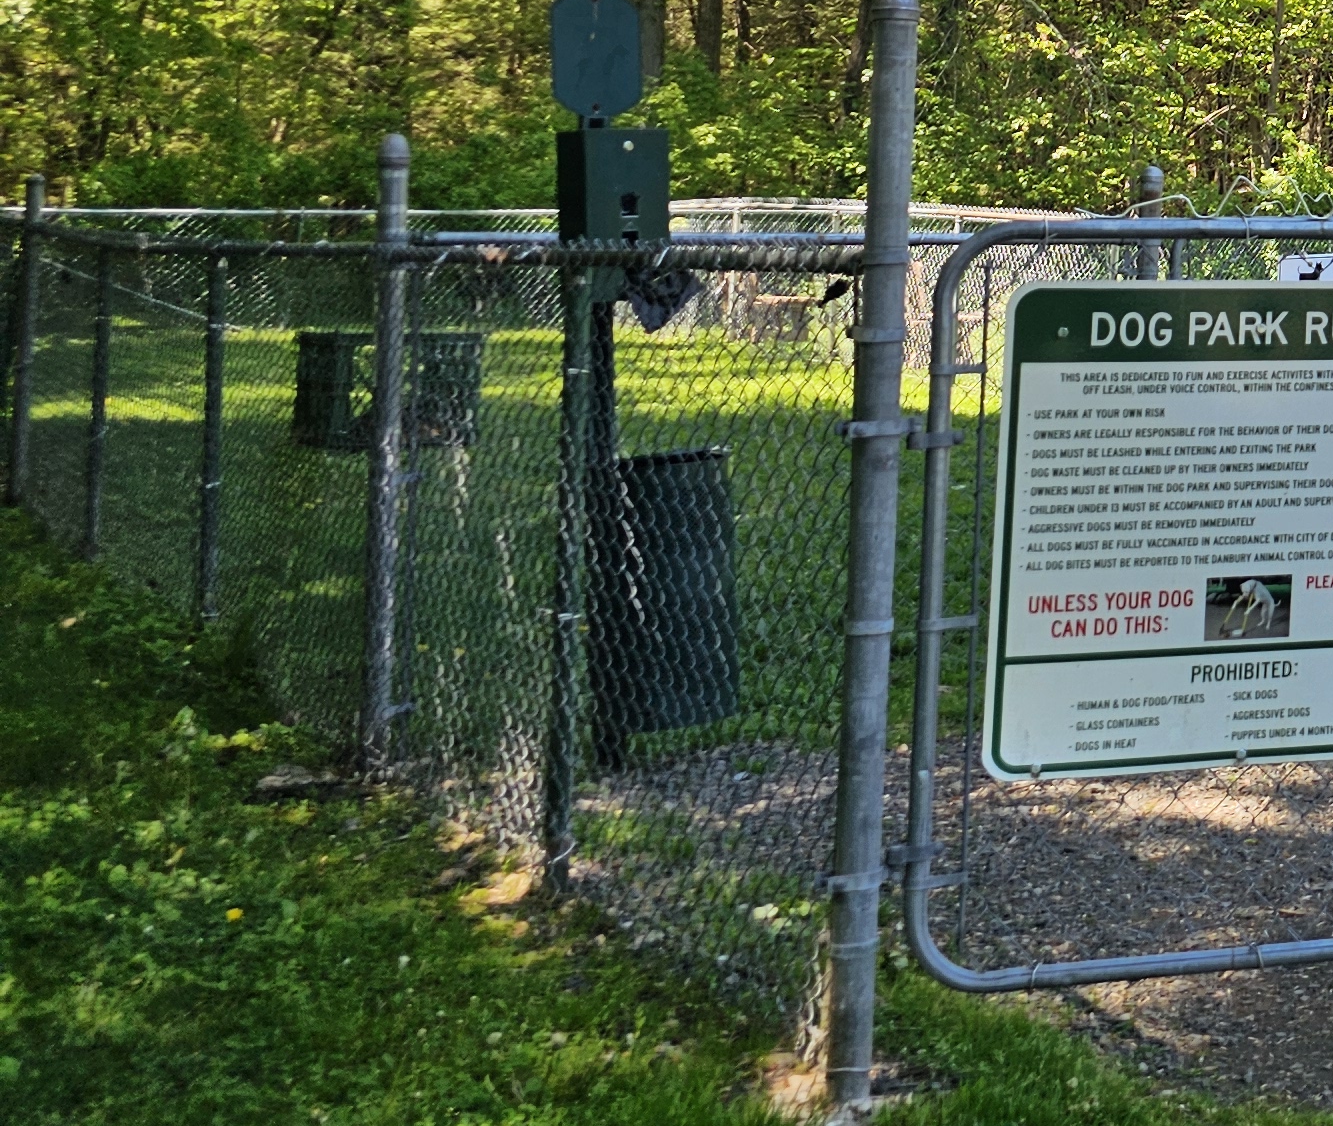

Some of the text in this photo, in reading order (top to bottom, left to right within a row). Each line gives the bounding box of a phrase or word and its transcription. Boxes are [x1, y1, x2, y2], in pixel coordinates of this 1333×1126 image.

[1090, 311, 1173, 347] DOG
[1188, 310, 1289, 346] PARK
[1060, 372, 1080, 382] THIS
[1083, 372, 1107, 381] AREA
[1110, 372, 1118, 381] IS
[1121, 372, 1169, 381] DEDICATED
[1172, 371, 1183, 381] TO
[1185, 371, 1203, 380] FUN
[1206, 371, 1224, 380] AND
[1227, 370, 1267, 380] EXERCISE
[1082, 384, 1100, 395] OFF
[1136, 384, 1166, 394] UNDER
[1169, 383, 1194, 393] VOICE
[1243, 382, 1272, 392] WITHIN
[1275, 382, 1291, 391] THE
[1293, 381, 1333, 391] CONFINES
[1033, 407, 1165, 420] USE PARK AT YOUR OWN RISK
[1032, 443, 1316, 459] DOGS MUST BE LEASHED WHILE ENTERING AND EXITING THE PARK
[1027, 516, 1255, 534] AGGRESSIVE DOGS MUST BE REMOVED IMMEDIATELY
[1026, 542, 1044, 552] ALL
[1047, 541, 1072, 552] DOGS
[1074, 540, 1099, 551] MUST
[1101, 539, 1113, 550] BE
[1116, 538, 1143, 549] FULLY
[1146, 536, 1198, 548] VACCINATED
[1201, 536, 1210, 546] IN
[1212, 534, 1270, 546] ACCORDANCE
[1273, 533, 1294, 543] WITH
[1296, 532, 1315, 542] CITY
[1317, 532, 1328, 542] OF
[1025, 561, 1043, 571] ALL
[1045, 560, 1064, 570] DOG
[1065, 559, 1091, 570] BITES
[1093, 558, 1116, 568] MUST
[1119, 557, 1131, 568] BE
[1133, 555, 1178, 567] REPORTED
[1180, 555, 1191, 565] TO
[1193, 554, 1209, 564] THE
[1211, 553, 1251, 564] DANBURY
[1253, 552, 1285, 562] ANIMAL
[1287, 550, 1325, 561] CONTROL
[1028, 589, 1193, 614] UNLESS YOUR DOG
[1051, 614, 1168, 638] CAN DO THIS:
[1190, 659, 1298, 683] PROHIBITED:
[1076, 693, 1205, 710] HUMAN & DOG FOOD/TREATS
[1232, 689, 1278, 701] SICK DOGS
[1232, 706, 1310, 721] AGGRESSIVE DOGS
[1075, 716, 1160, 731] GLASS CONTAINERS
[1231, 729, 1266, 740] PUPPIES
[1268, 727, 1296, 738] UNDER
[1299, 727, 1304, 736] 4
[1074, 738, 1136, 751] DOGS IN HEAT
